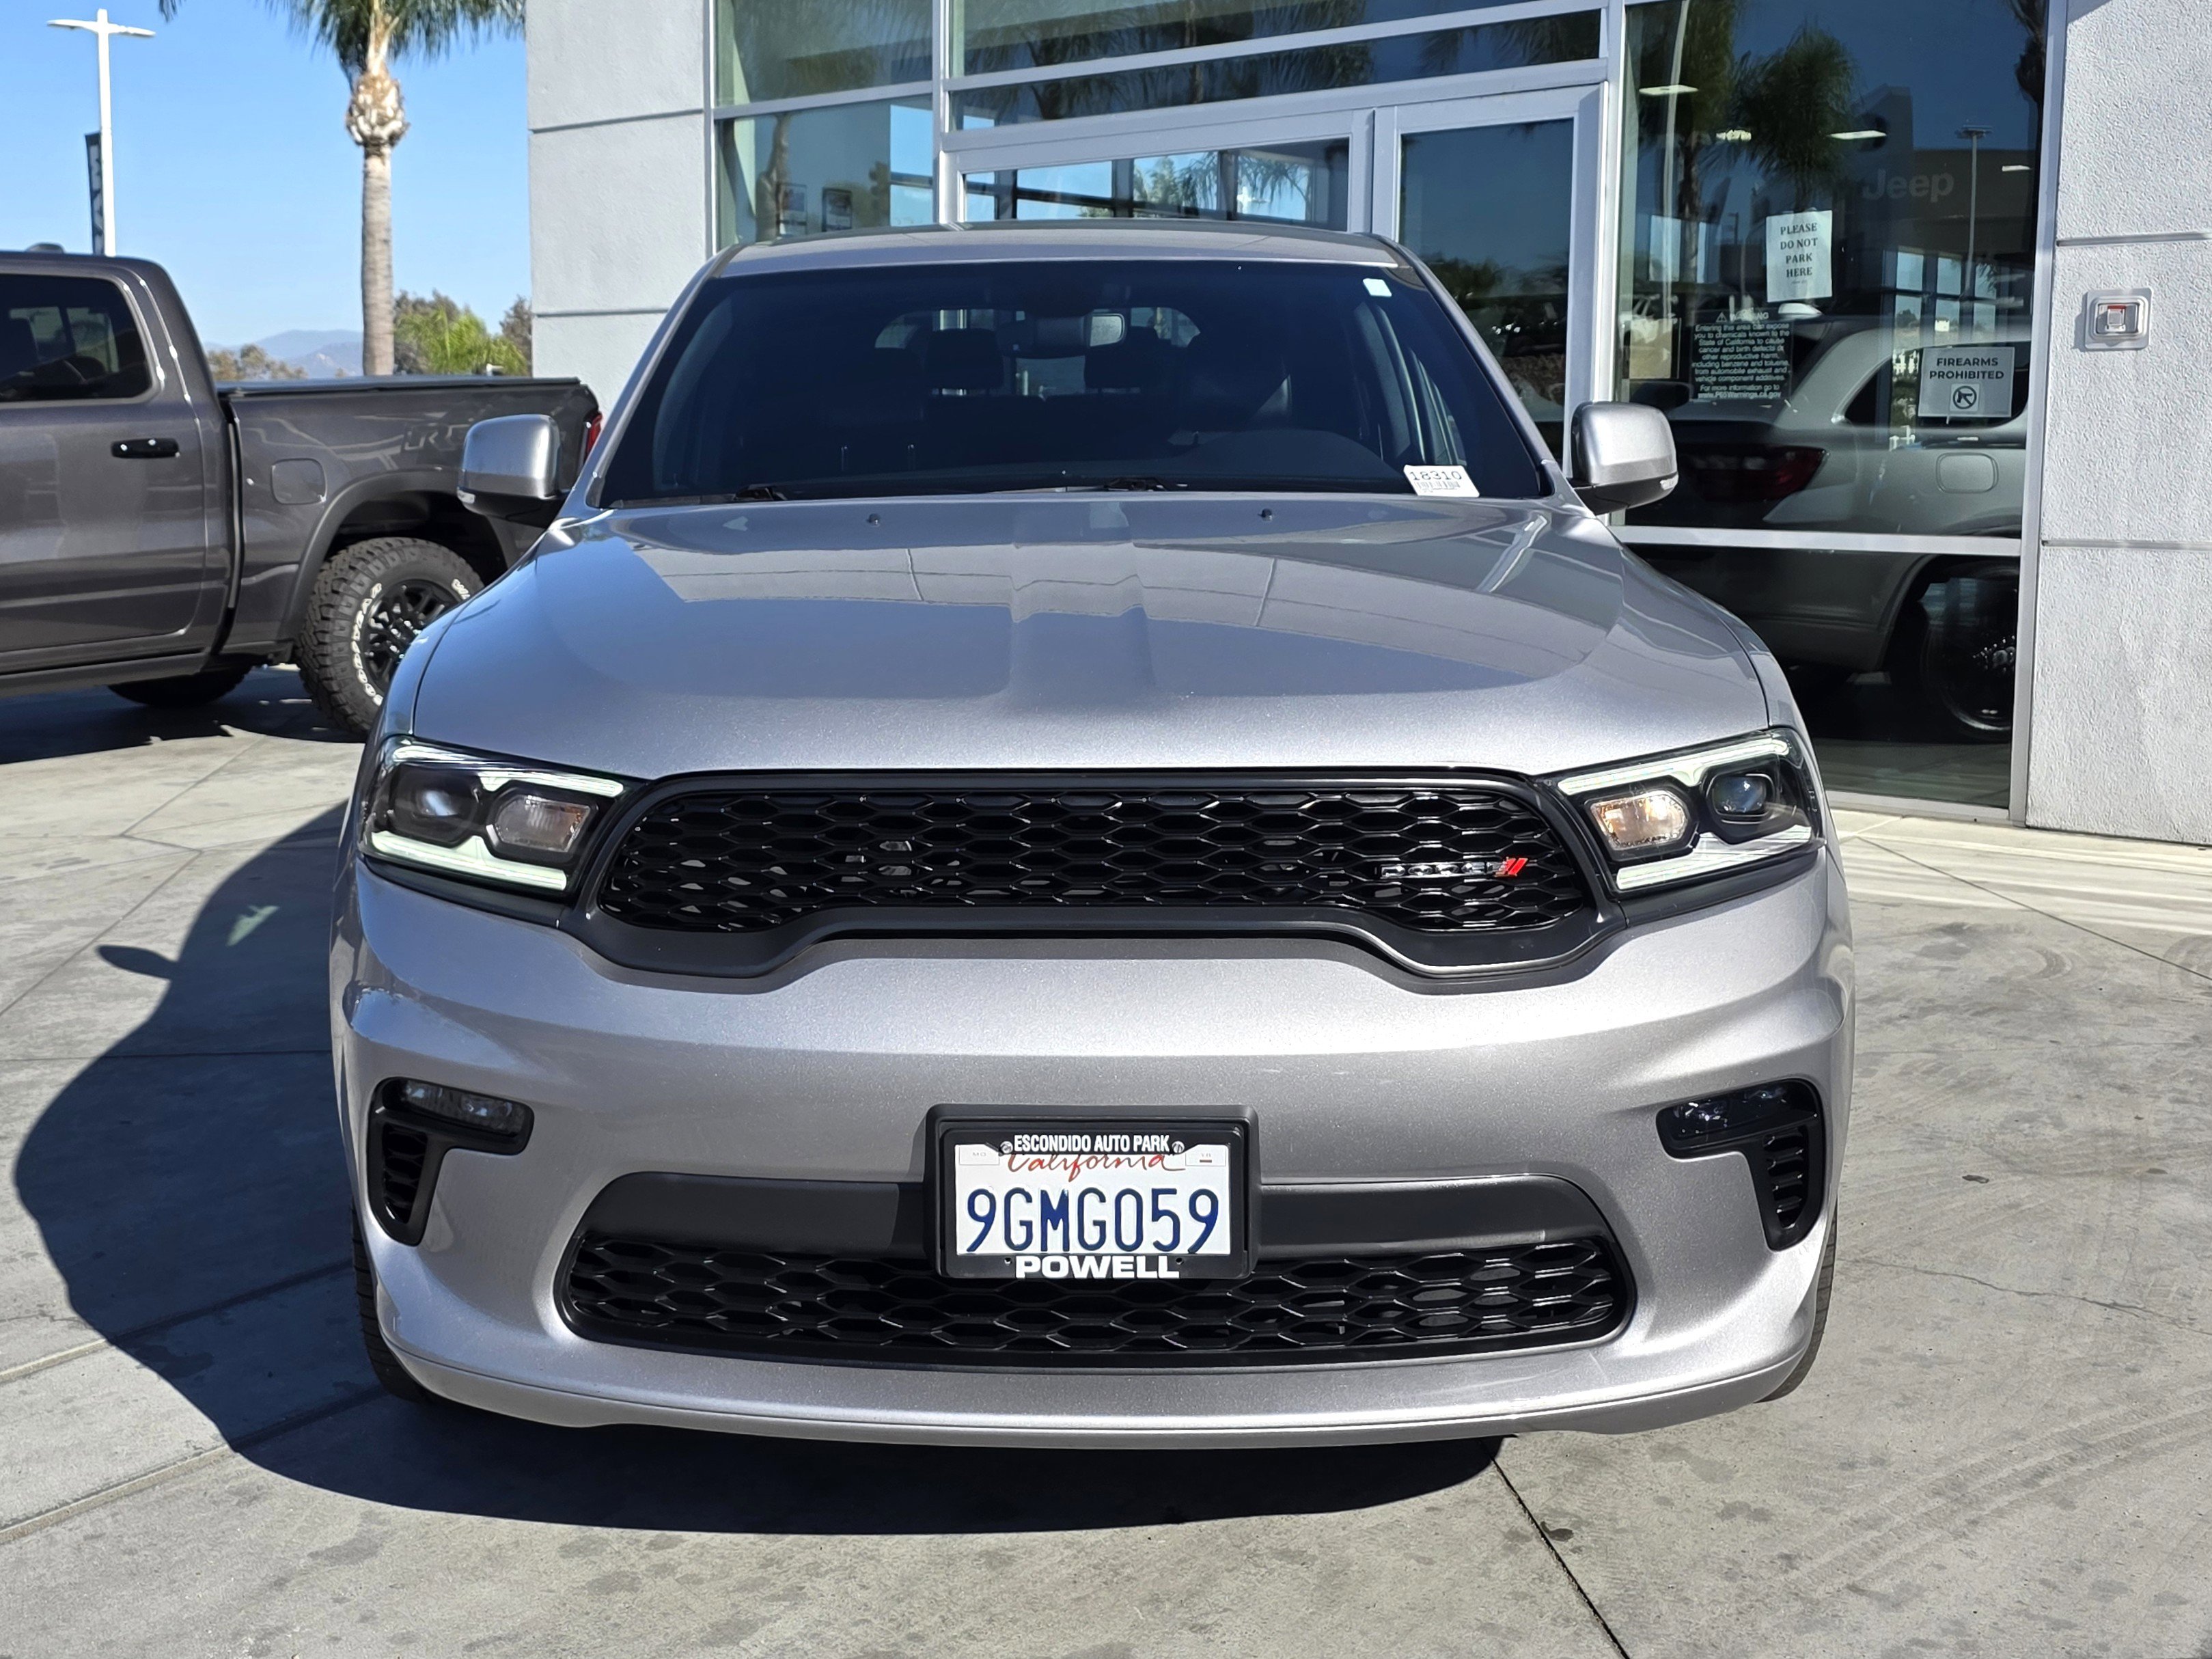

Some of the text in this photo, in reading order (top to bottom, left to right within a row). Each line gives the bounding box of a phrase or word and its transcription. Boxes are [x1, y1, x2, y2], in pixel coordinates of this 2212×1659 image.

[1862, 169, 1954, 203] Jeep
[1780, 223, 1817, 235] PLEASE
[1780, 238, 1818, 250] DO NOT
[1786, 253, 1812, 264] PARK
[1786, 267, 1812, 277] HERE
[1937, 357, 1998, 366] FIREARMS
[1929, 370, 2004, 379] PROHIBITED
[1410, 471, 1462, 480] 18310
[1014, 1134, 1170, 1151] ESCONDIDO AUTO PARK
[1008, 1153, 1185, 1182] California
[966, 1186, 1219, 1254] 9GMG059
[1016, 1255, 1179, 1278] POWELL
